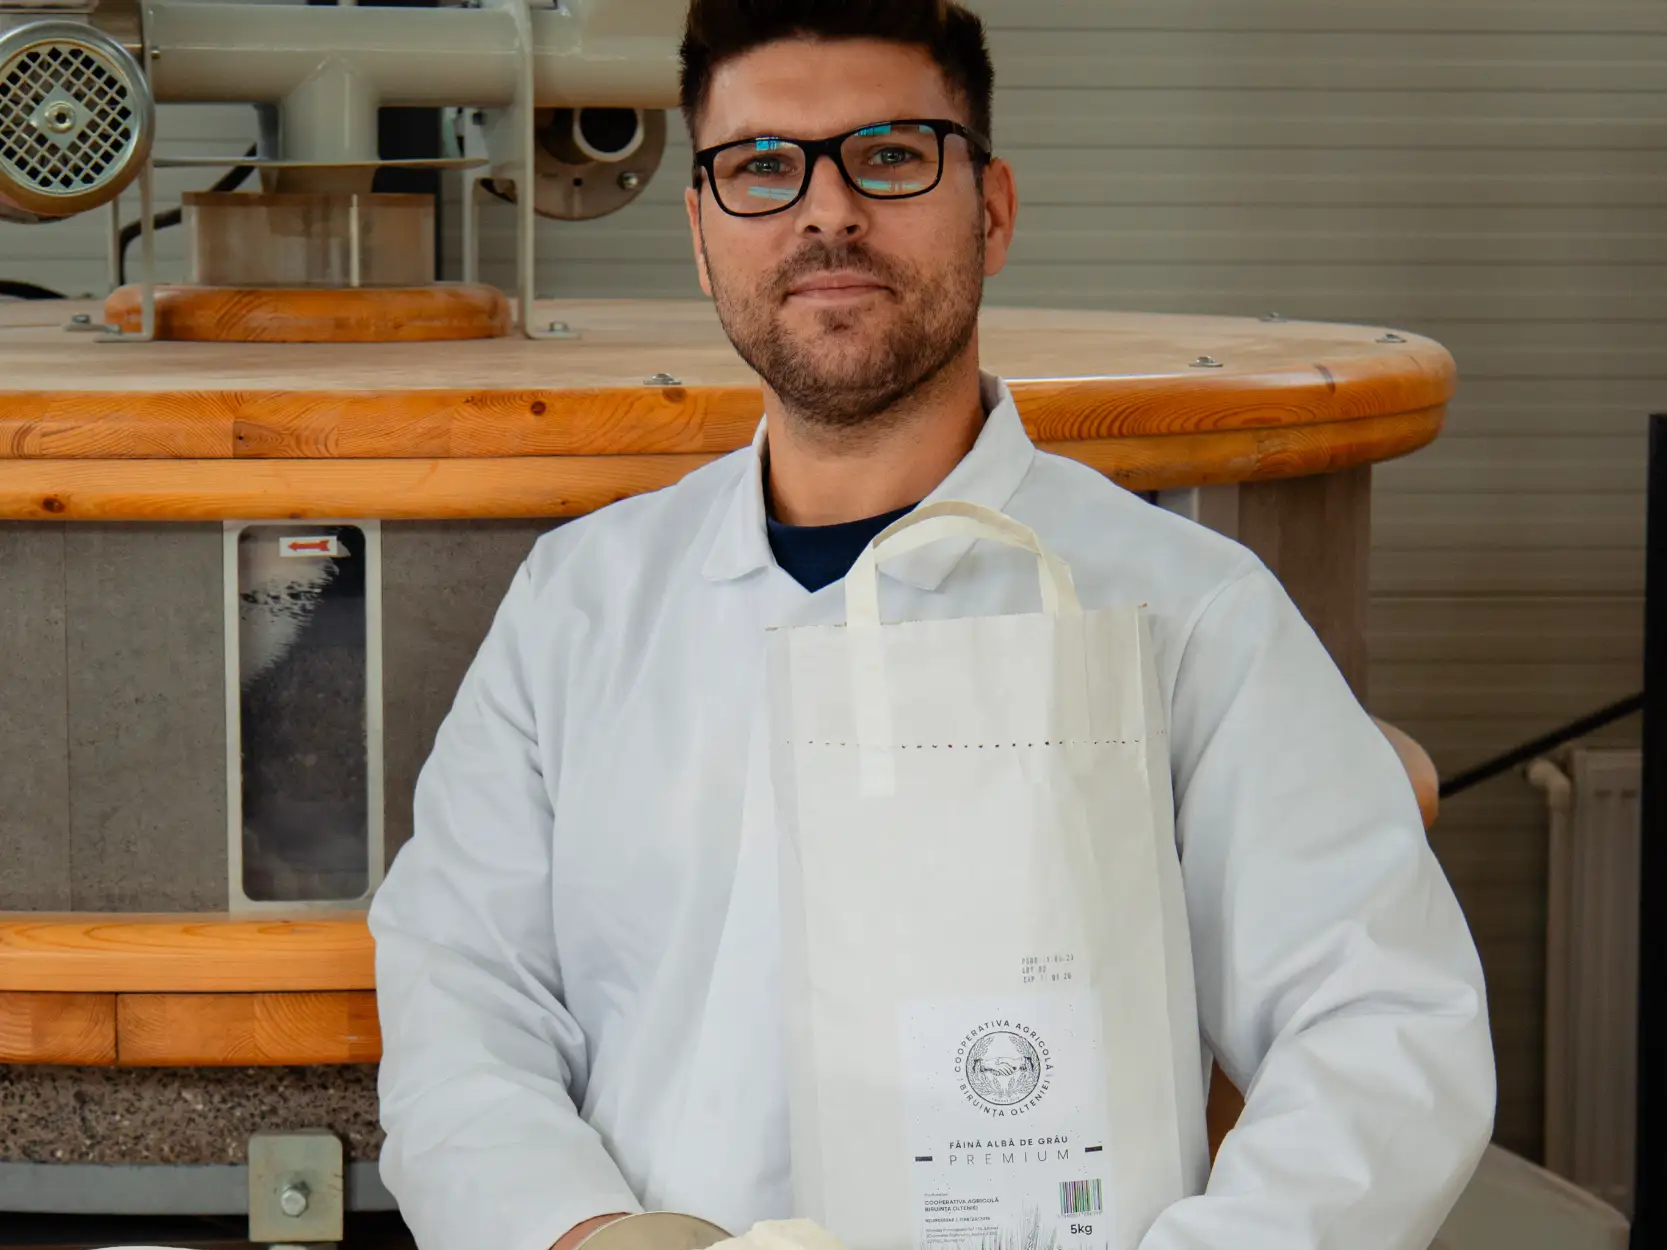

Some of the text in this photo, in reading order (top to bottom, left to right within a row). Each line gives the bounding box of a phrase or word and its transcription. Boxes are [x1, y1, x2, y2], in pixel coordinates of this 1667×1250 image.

[954, 1020, 1010, 1072] COOPERATIVA
[1010, 1080, 1050, 1116] OLTENIEI
[950, 1140, 982, 1149] FĂINĂ
[987, 1138, 1015, 1148] ALBĂ
[1038, 1135, 1068, 1144] GRÂU
[950, 1150, 1069, 1166] PREMIUM
[1070, 1224, 1092, 1235] 5kg
